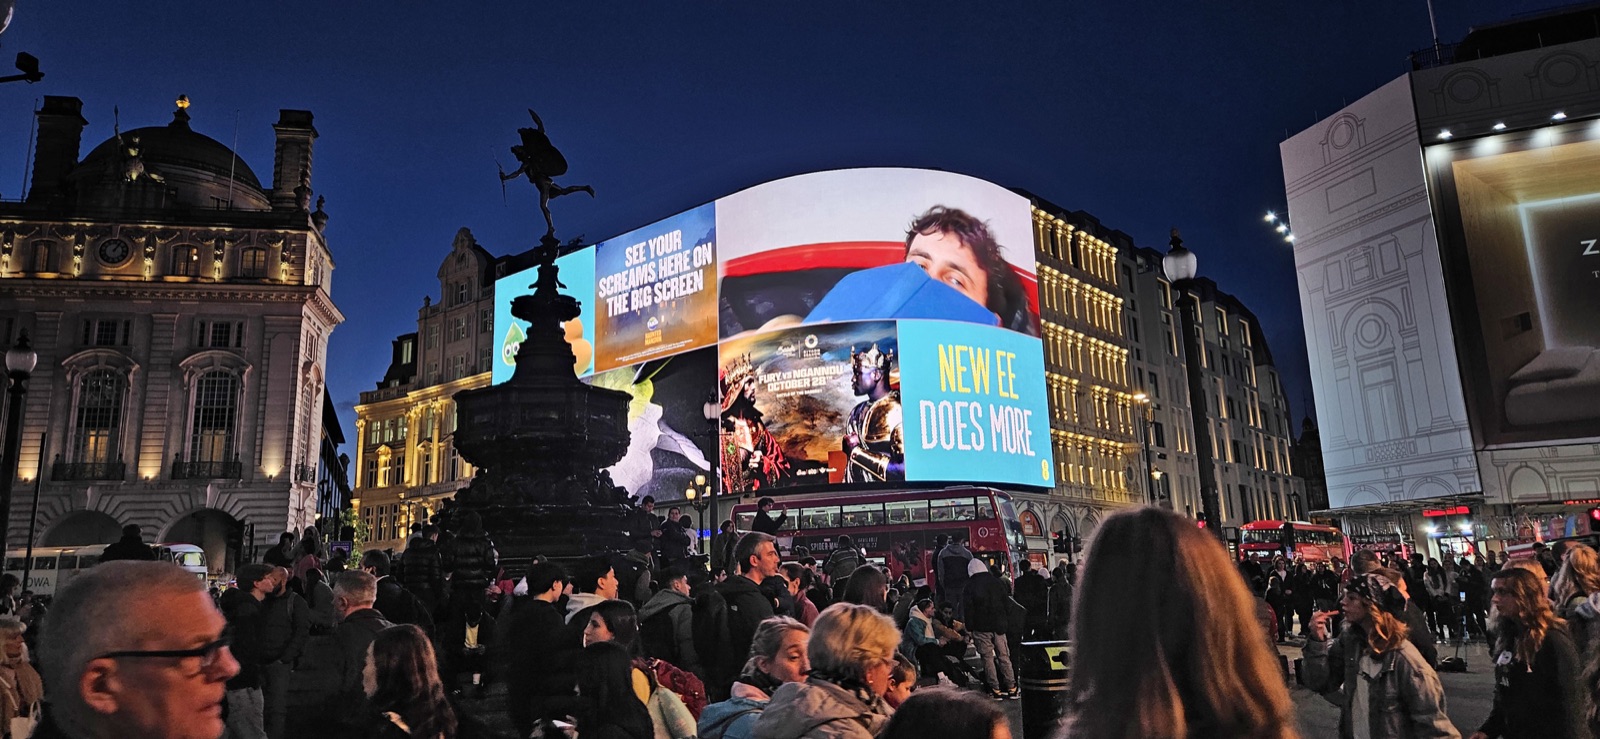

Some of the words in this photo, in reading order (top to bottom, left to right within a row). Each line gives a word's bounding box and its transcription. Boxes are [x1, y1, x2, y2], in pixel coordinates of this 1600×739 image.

[598, 261, 656, 298] SCREAMS
[658, 249, 691, 280] HERE
[693, 242, 713, 268] ON
[625, 242, 647, 267] SEE
[648, 229, 682, 259] YOUR
[606, 292, 629, 318] THE
[631, 285, 653, 312] BIG
[654, 269, 704, 304] SCREEN
[758, 371, 781, 384] FURY
[793, 365, 845, 380] NGANNOU
[768, 378, 810, 392] OCTOBER
[938, 343, 990, 395] NEW
[996, 350, 1019, 400] EE
[919, 399, 985, 451] DOES
[989, 403, 1036, 457] MORE
